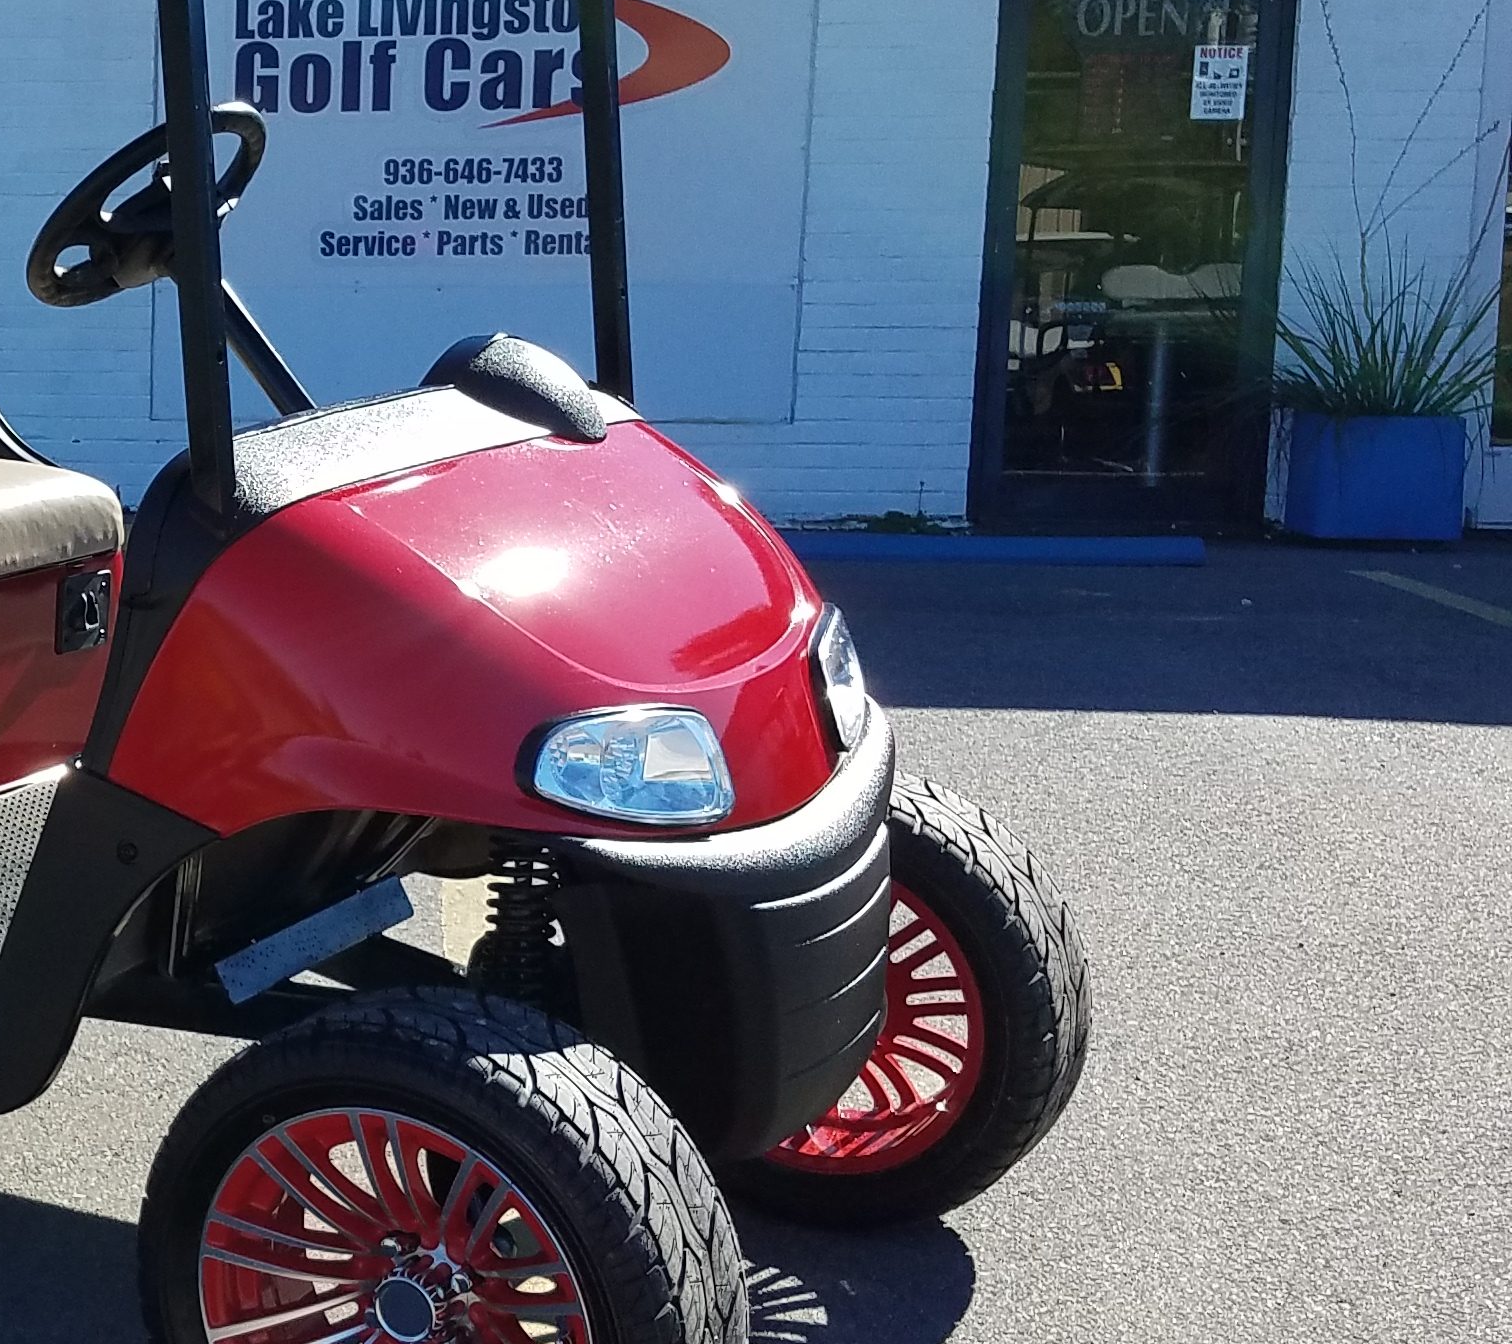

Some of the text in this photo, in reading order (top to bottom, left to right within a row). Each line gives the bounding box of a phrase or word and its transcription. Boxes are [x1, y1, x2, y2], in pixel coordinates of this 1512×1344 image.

[1200, 47, 1244, 59] NOTICE
[235, 40, 397, 114] Golf
[383, 157, 563, 185] 936-646-7433
[353, 193, 589, 221] Sales New & Used
[320, 230, 416, 256] Service
[437, 229, 503, 256] Parts
